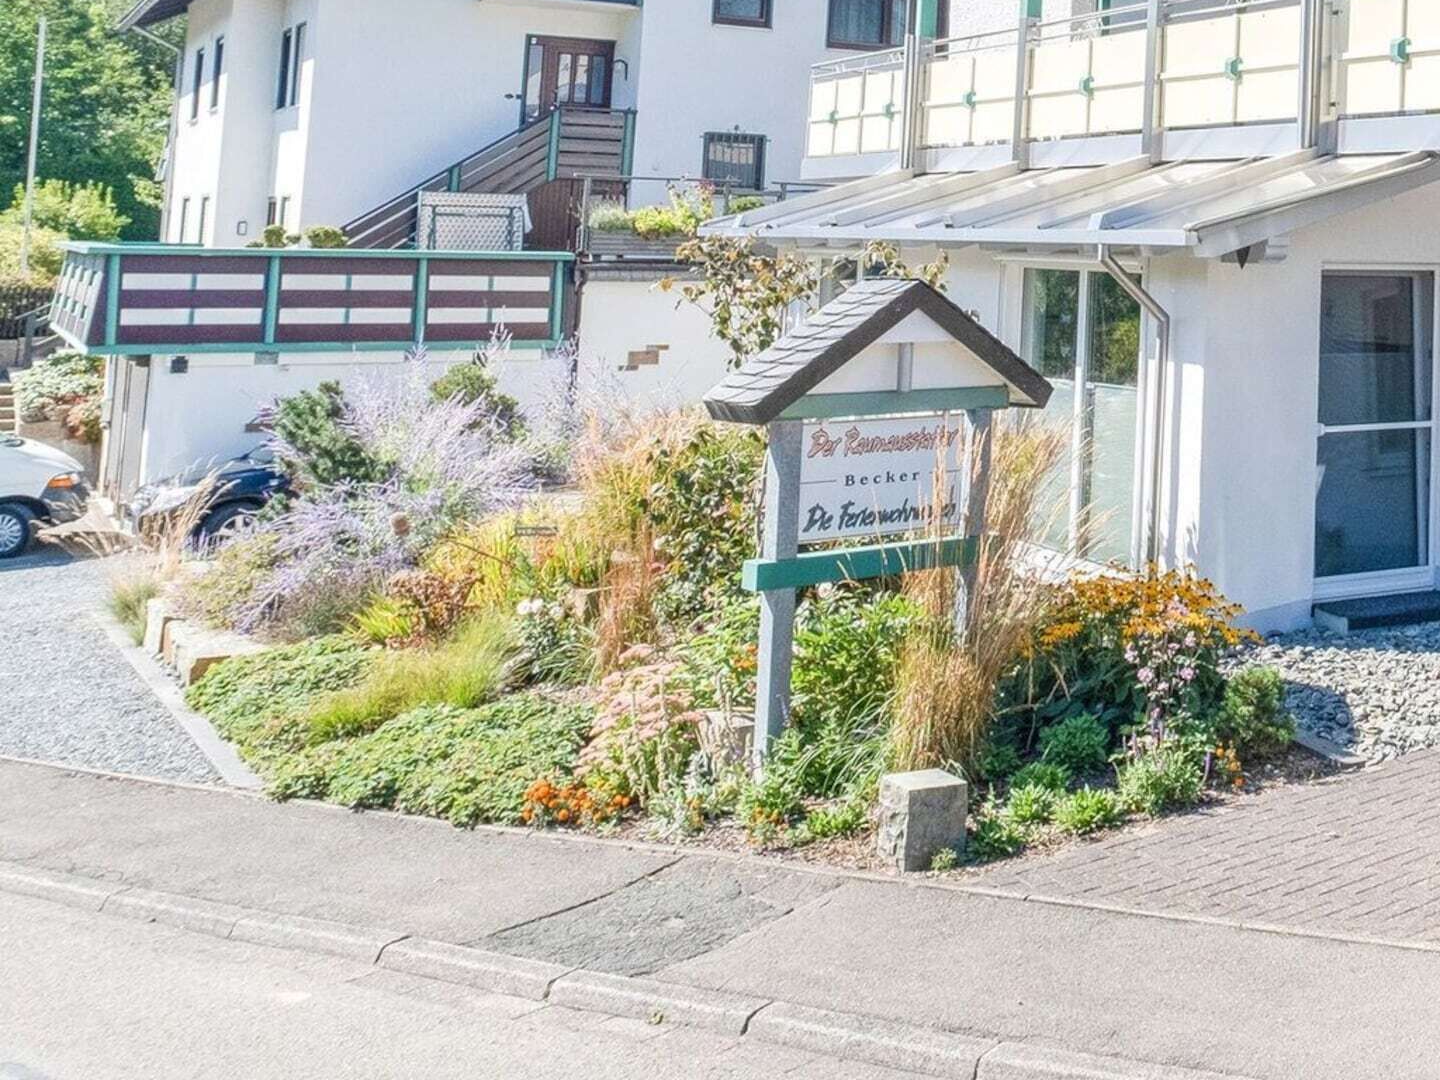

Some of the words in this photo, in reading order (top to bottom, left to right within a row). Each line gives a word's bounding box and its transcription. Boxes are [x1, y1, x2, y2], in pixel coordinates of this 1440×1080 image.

[807, 428, 842, 459] Der
[845, 471, 920, 487] Becker
[802, 503, 834, 533] Die
